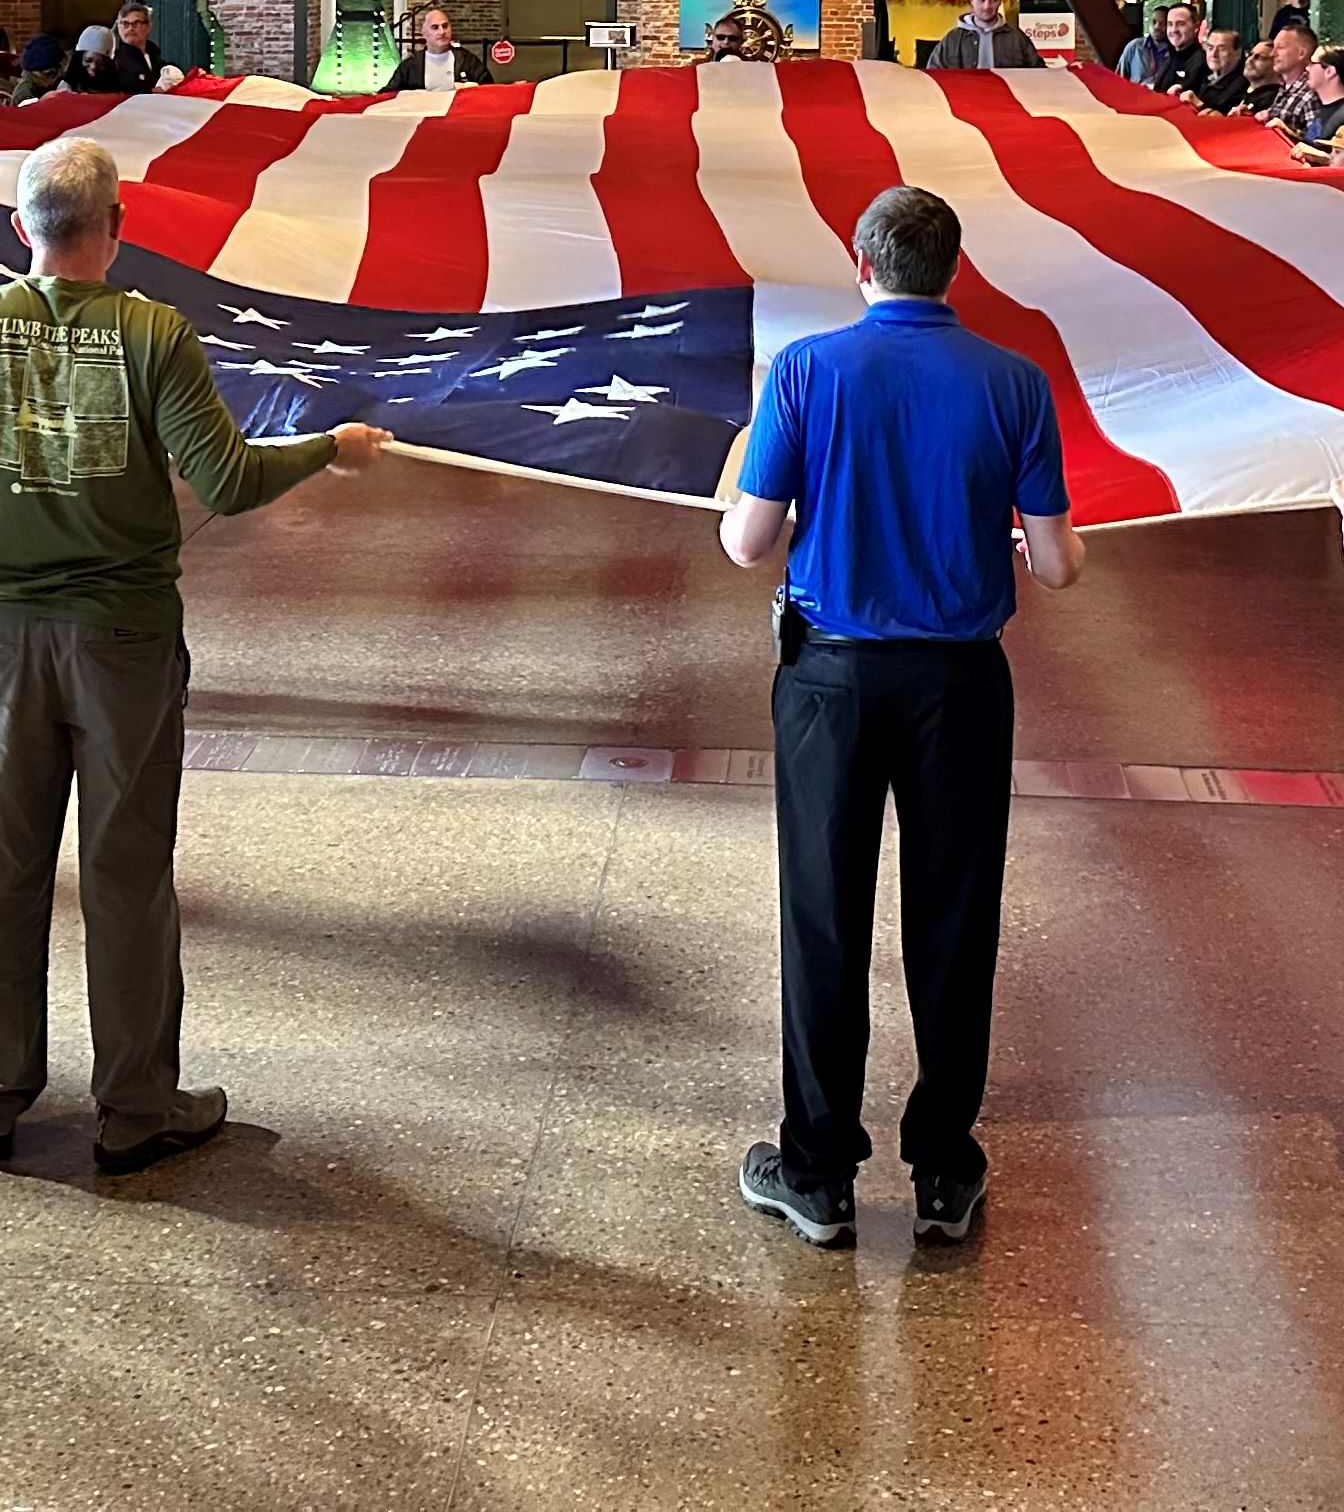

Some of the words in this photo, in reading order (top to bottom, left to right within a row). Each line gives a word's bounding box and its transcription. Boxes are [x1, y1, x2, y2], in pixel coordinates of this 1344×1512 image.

[1025, 29, 1057, 40] Steps
[42, 324, 69, 343] THE
[71, 328, 120, 345] PEAKS
